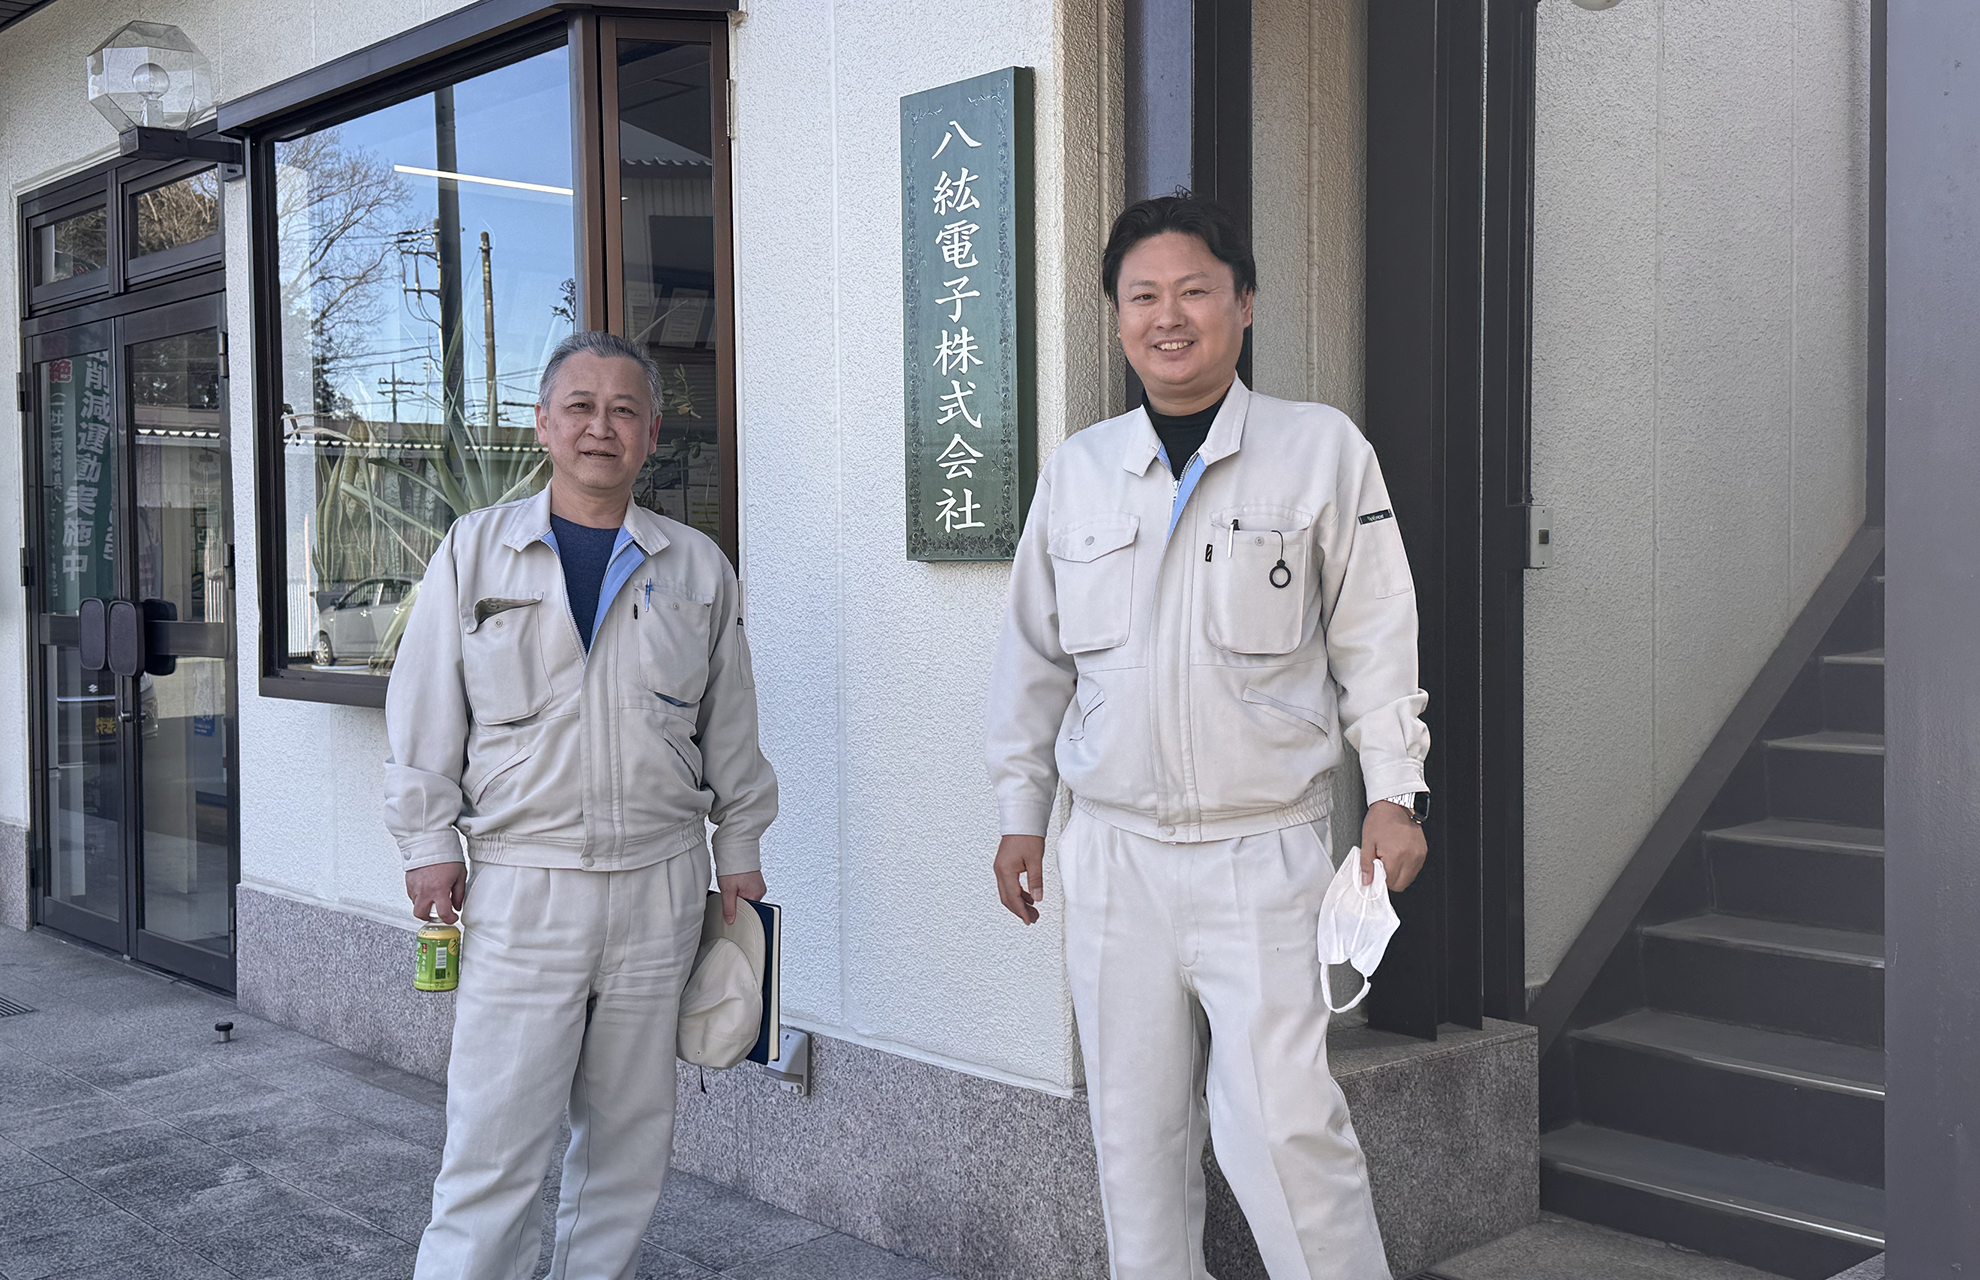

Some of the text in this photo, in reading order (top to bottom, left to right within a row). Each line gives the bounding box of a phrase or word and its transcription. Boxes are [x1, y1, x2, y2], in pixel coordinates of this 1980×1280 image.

[62, 351, 110, 581] 削減運動実施中
[932, 119, 985, 534] 八紘電子株式会社
